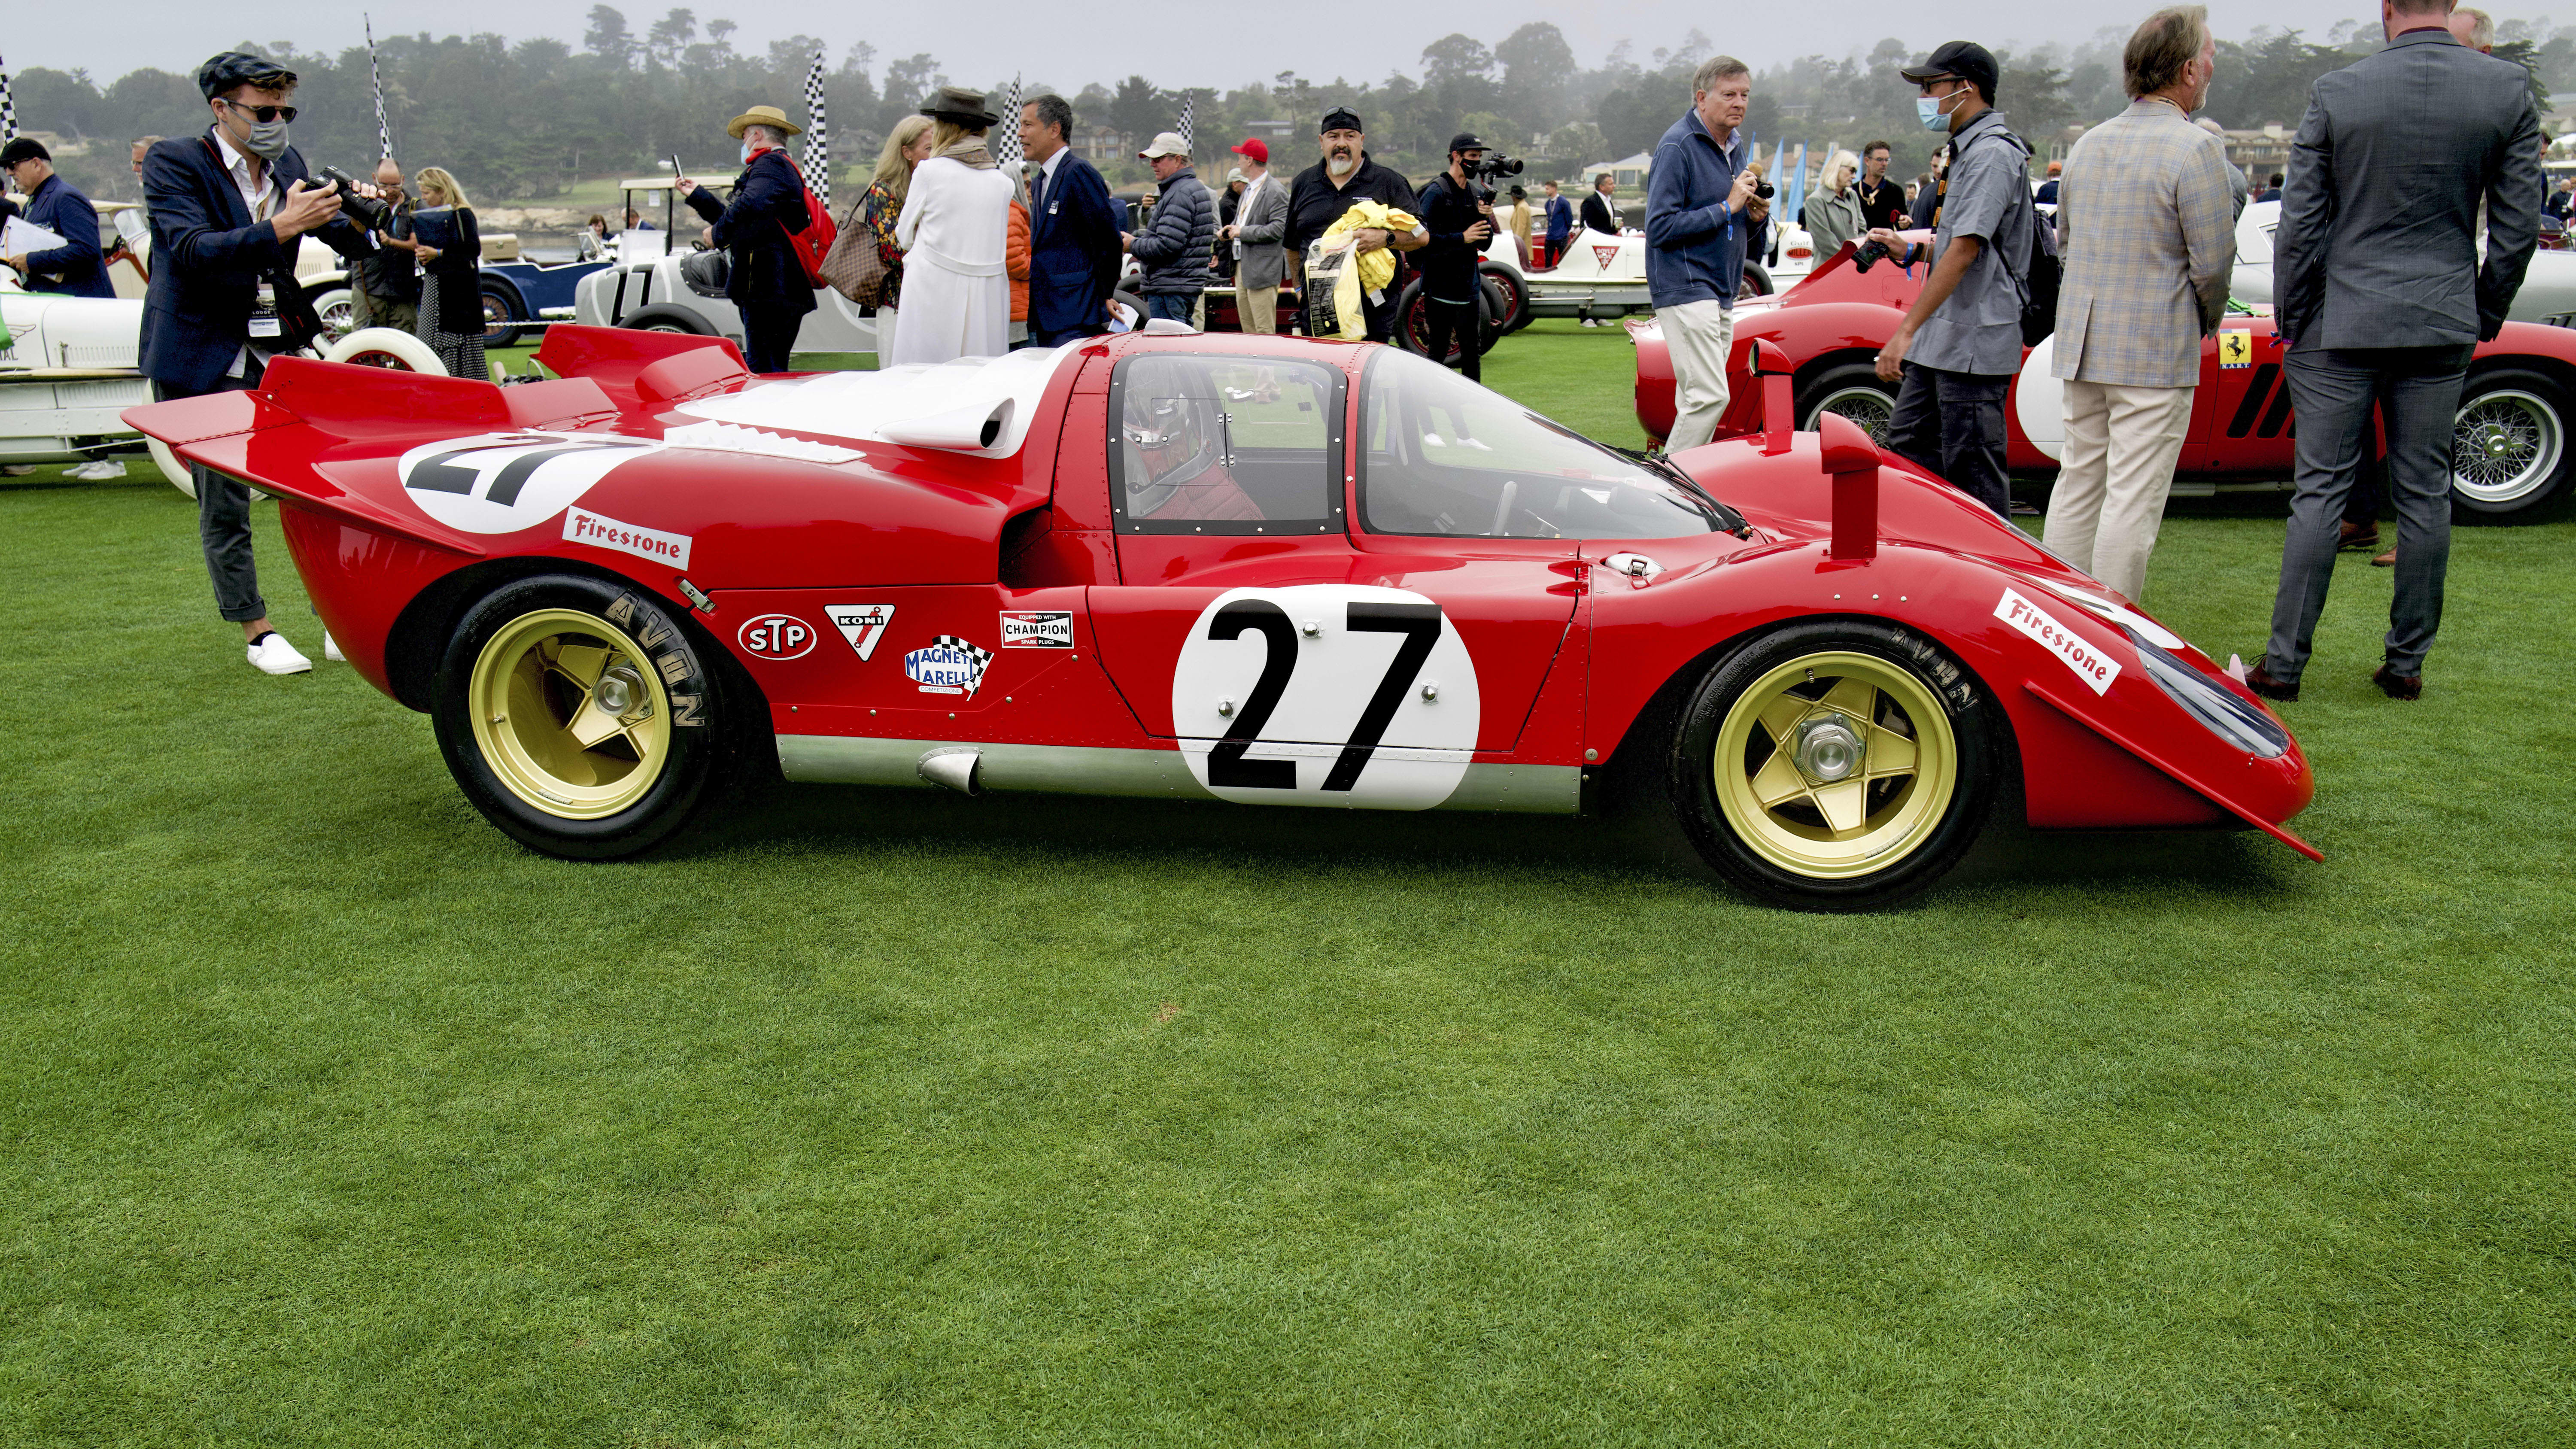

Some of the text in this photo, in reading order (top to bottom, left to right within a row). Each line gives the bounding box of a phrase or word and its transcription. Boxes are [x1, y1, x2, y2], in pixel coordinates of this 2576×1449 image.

[405, 435, 647, 507] 27
[574, 514, 680, 558] Firestone
[604, 590, 705, 727] AVON
[749, 618, 806, 653] STP
[905, 649, 973, 675] MAGNETI
[1005, 625, 1067, 635] CHAMPION
[2008, 598, 2107, 680] Firestone
[1207, 599, 1442, 792] 27
[1696, 709, 1705, 724] FOR
[1704, 682, 1722, 706] RACING
[1723, 650, 1755, 679] PURPOSES
[1759, 638, 1775, 650] ONLY
[1705, 703, 1714, 717] NOT
[1714, 685, 1725, 699] FOR
[1726, 660, 1752, 683] HIGHWAY
[1885, 627, 1980, 713] AVON
